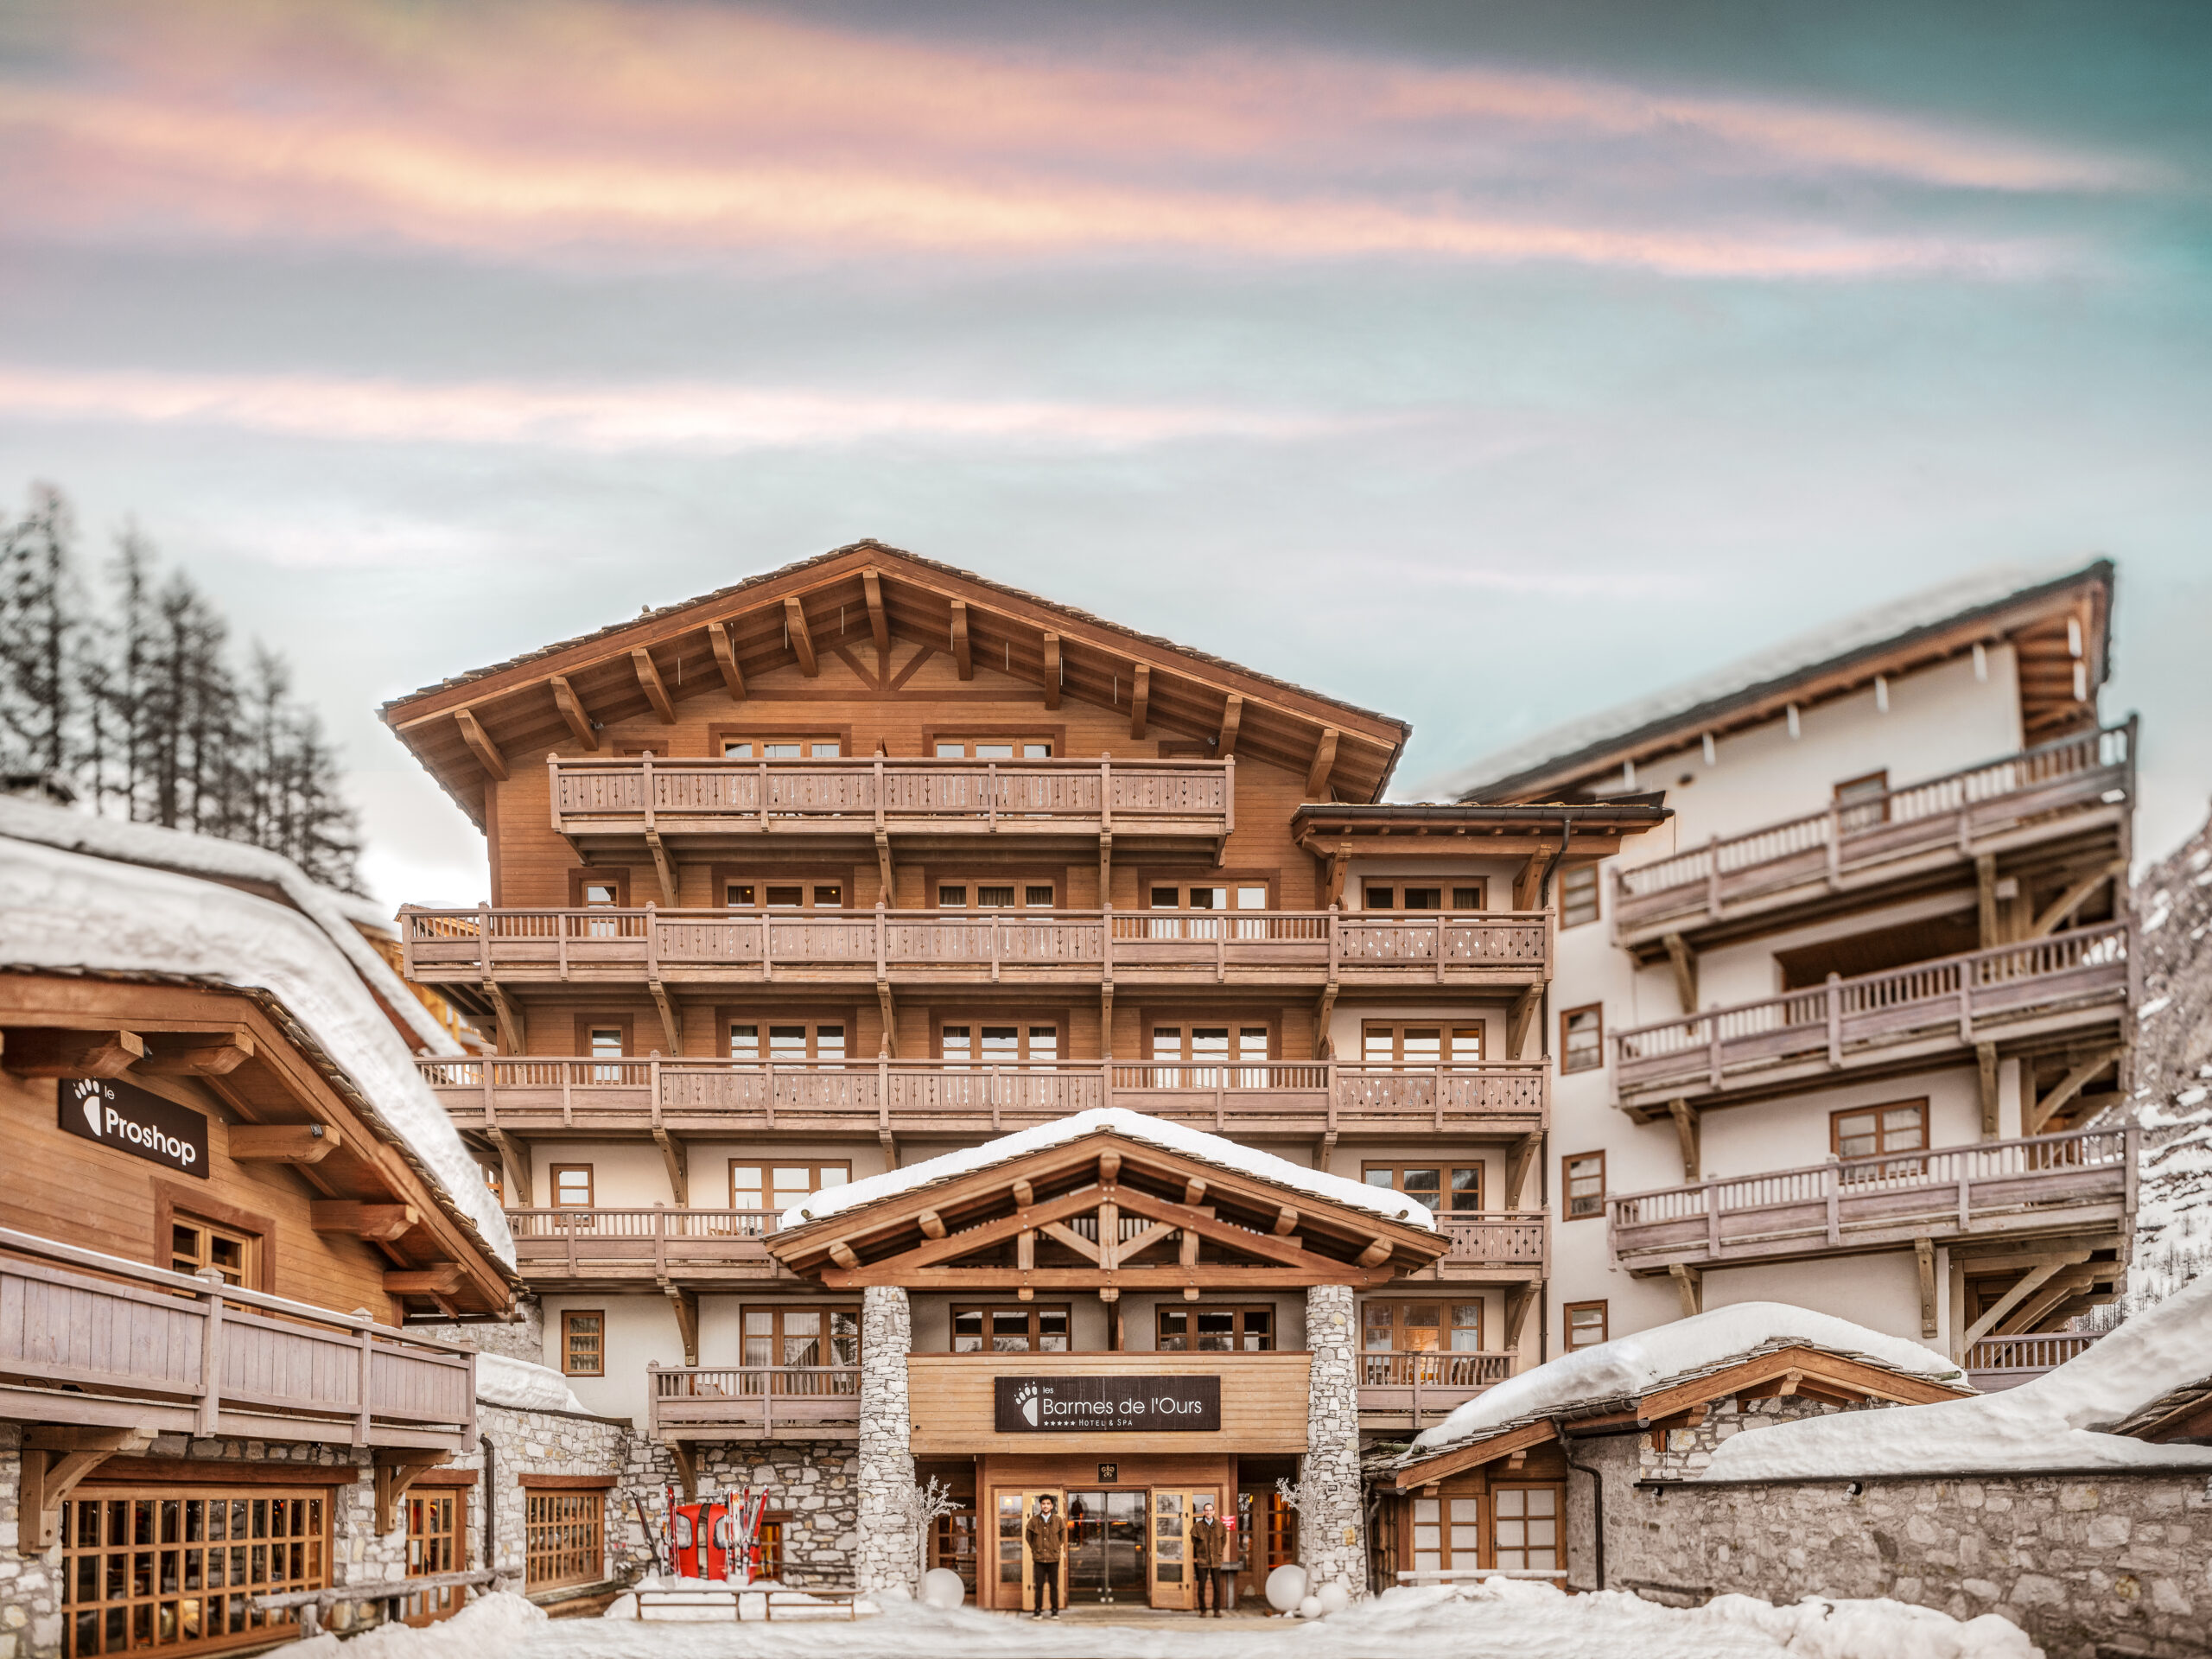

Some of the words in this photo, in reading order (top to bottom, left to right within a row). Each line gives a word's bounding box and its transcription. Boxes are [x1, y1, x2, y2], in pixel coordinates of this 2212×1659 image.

[105, 1085, 115, 1100] le
[105, 1107, 196, 1166] Proshop
[1043, 1398, 1114, 1414] Barmes
[1119, 1397, 1145, 1414] de
[1151, 1397, 1202, 1414] l'Ours
[1116, 1418, 1133, 1427] SPA
